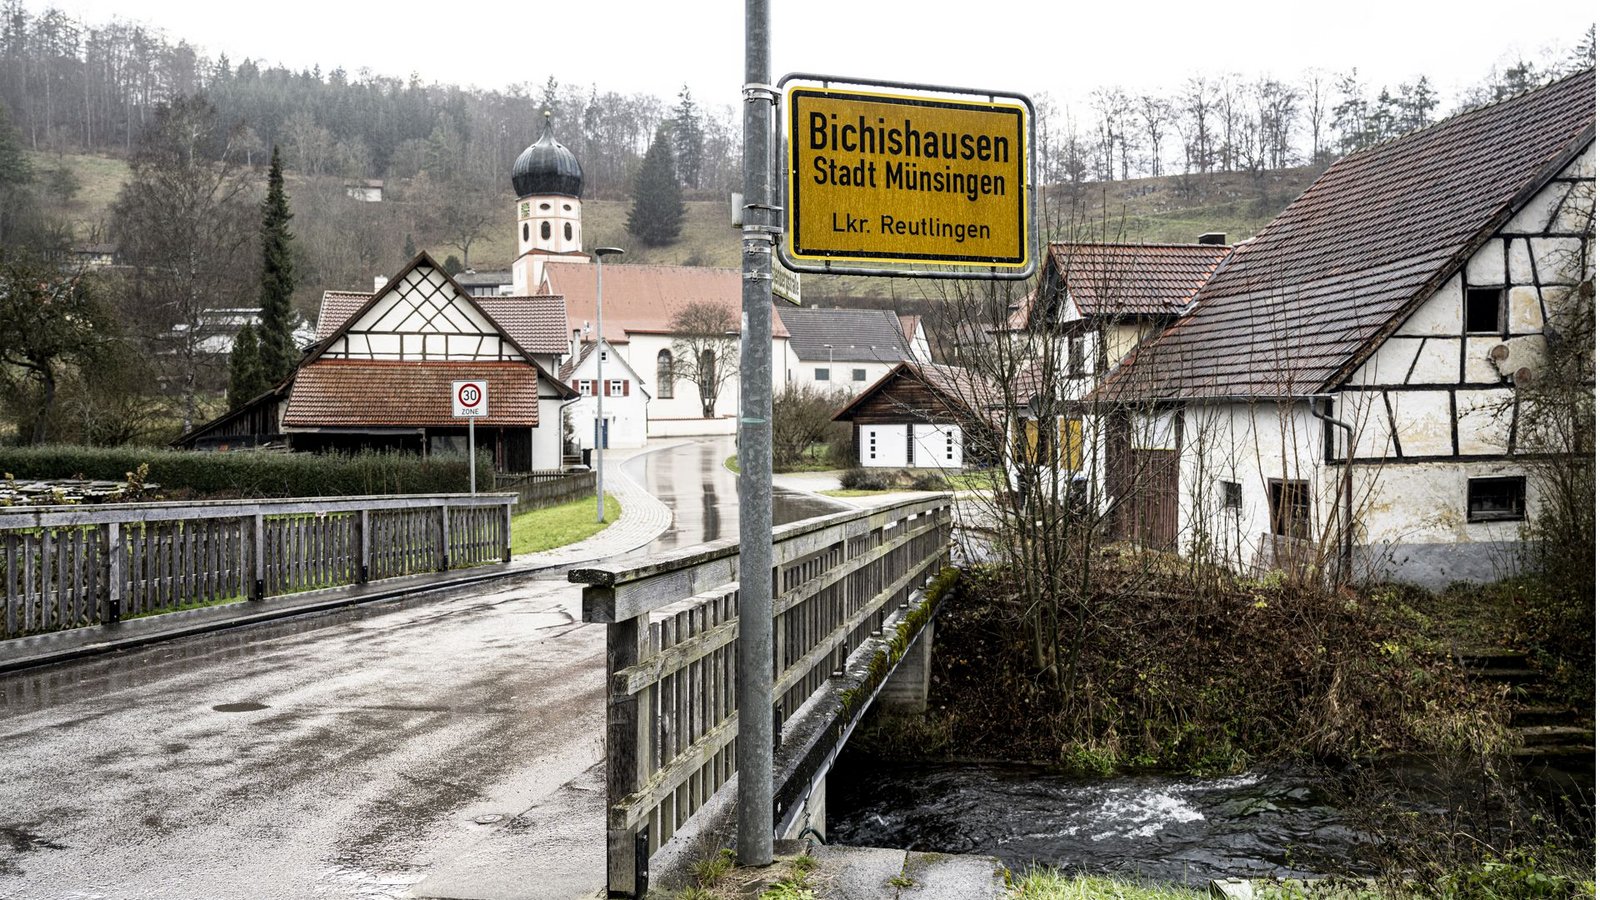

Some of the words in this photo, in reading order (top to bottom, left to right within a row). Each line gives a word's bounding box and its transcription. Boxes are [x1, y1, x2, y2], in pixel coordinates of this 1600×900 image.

[809, 111, 1009, 163] Bichishausen
[813, 156, 877, 189] Stadt
[885, 160, 1006, 202] Münsingen
[832, 212, 871, 234] Lkr.
[880, 214, 991, 243] Reutlingen
[463, 389, 477, 401] 30
